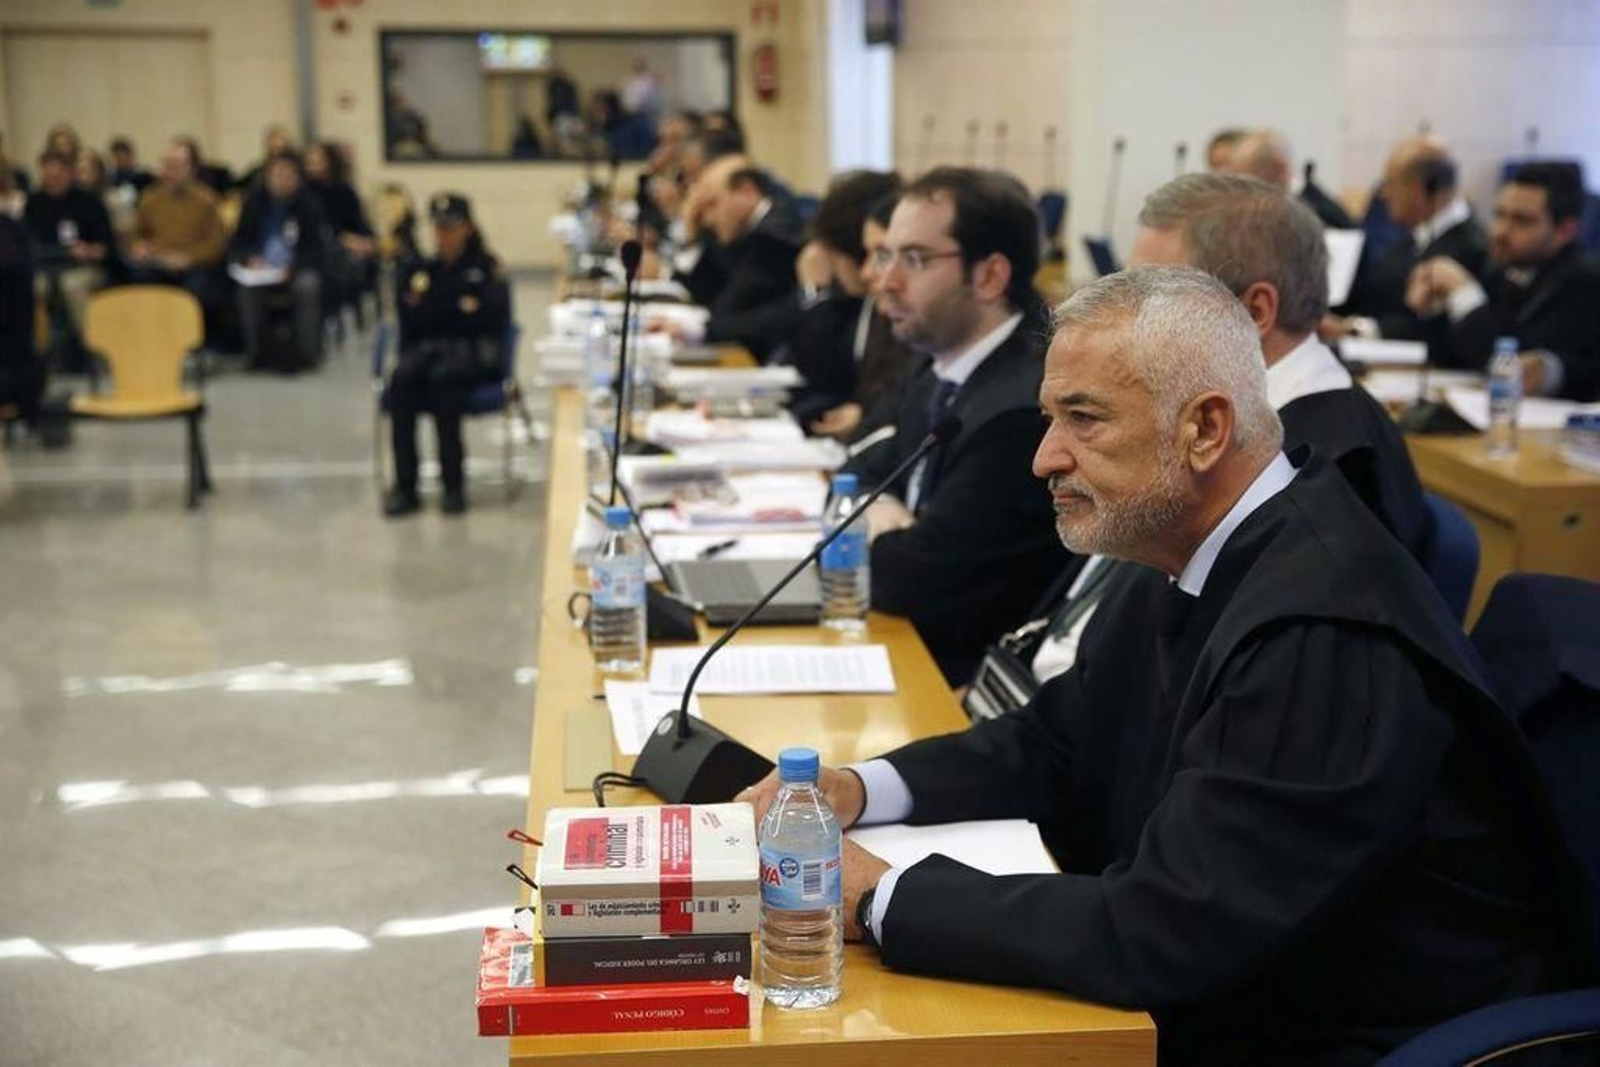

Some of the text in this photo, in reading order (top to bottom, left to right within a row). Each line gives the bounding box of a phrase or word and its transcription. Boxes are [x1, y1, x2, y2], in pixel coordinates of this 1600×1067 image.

[605, 823, 628, 868] criminal
[623, 960, 645, 968] PODER
[613, 1010, 644, 1019] PENAL
